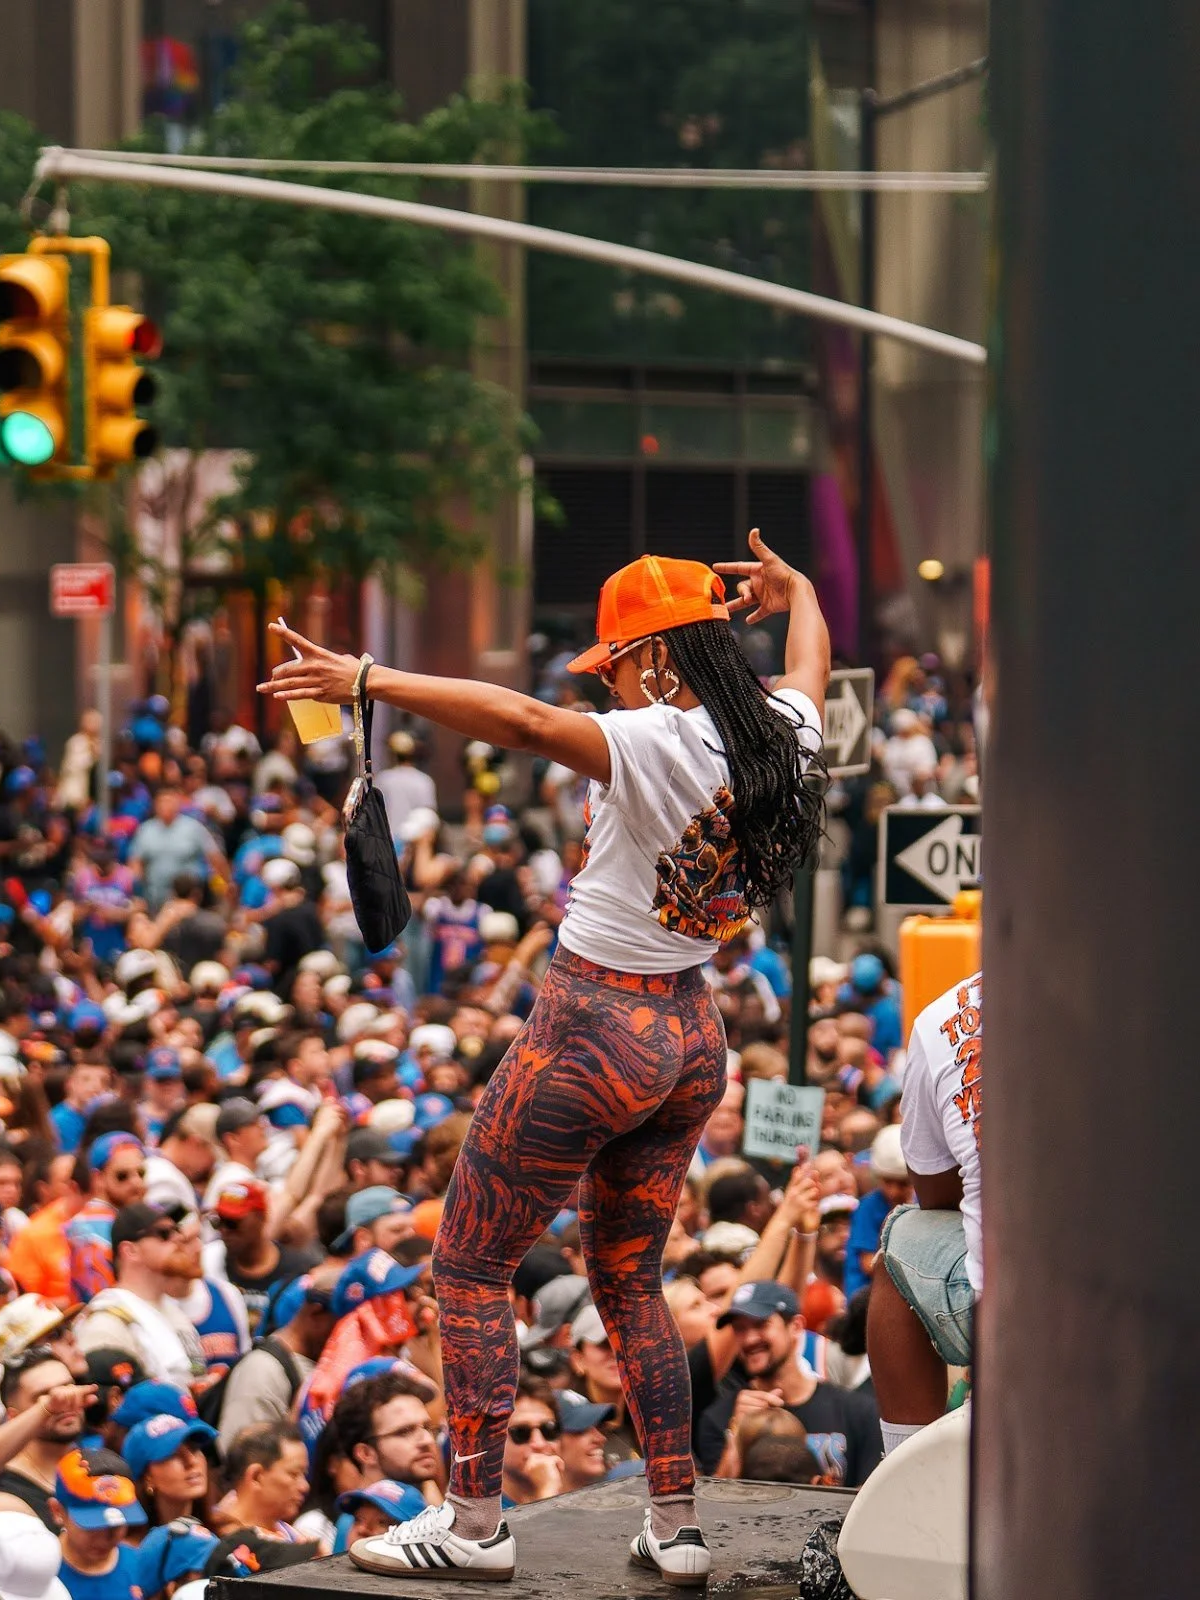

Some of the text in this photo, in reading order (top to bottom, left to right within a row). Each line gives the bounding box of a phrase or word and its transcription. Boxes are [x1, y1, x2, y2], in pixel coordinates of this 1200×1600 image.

[927, 840, 978, 876] ON
[940, 1006, 982, 1047] TO
[954, 1036, 982, 1088] 2
[952, 1084, 982, 1126] YE
